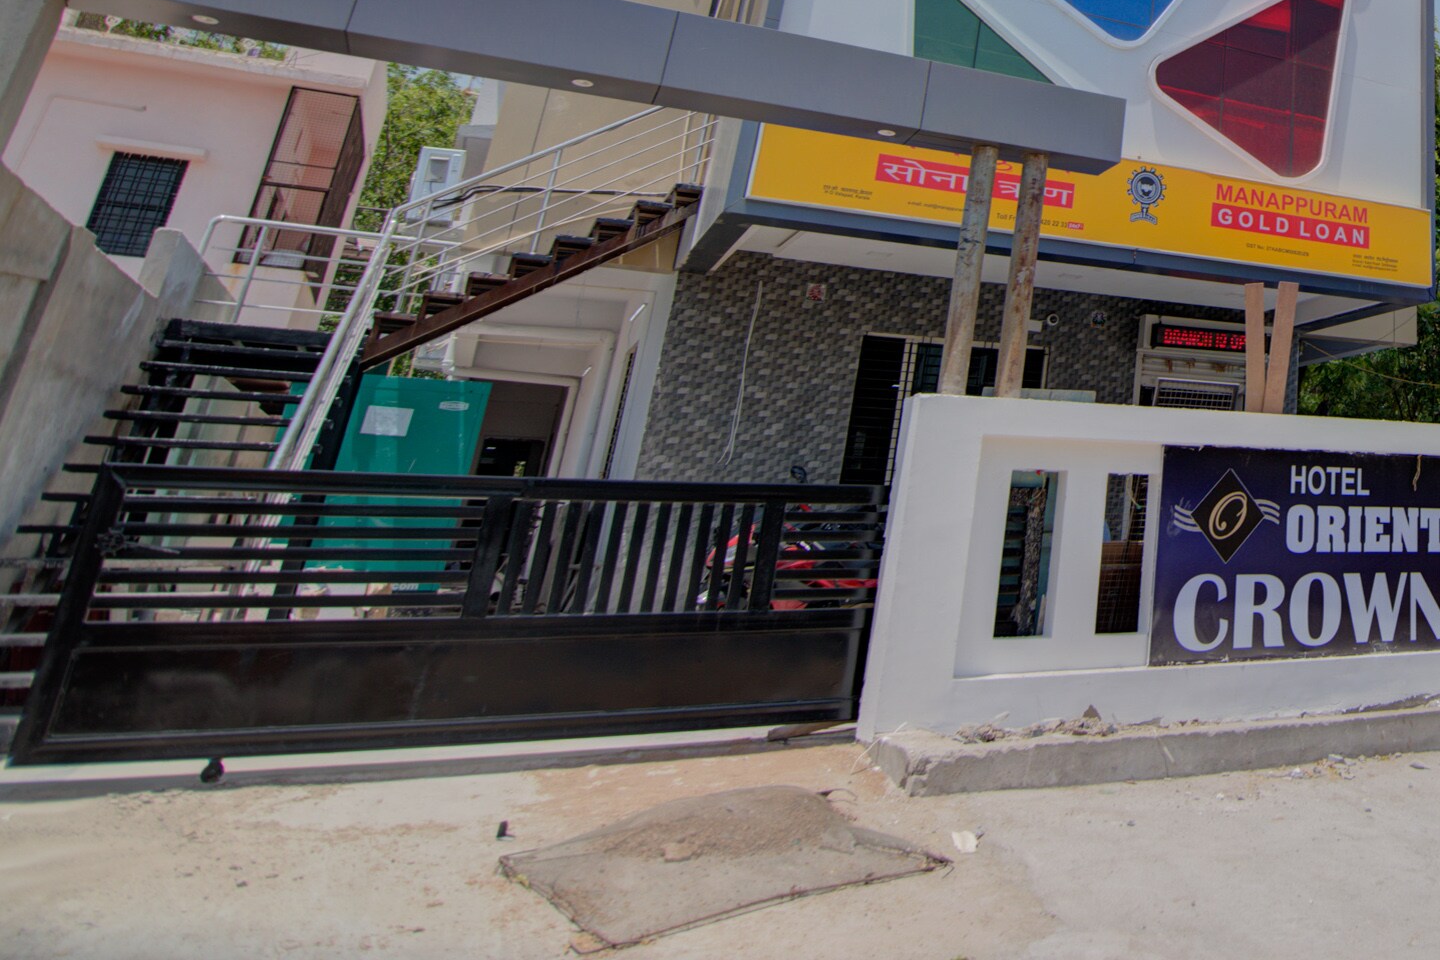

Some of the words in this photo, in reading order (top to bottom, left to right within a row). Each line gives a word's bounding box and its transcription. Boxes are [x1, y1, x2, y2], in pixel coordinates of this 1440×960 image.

[1215, 183, 1368, 224] MANAPPURAM
[1217, 208, 1289, 234] GOLD
[1299, 219, 1366, 246] LOAN
[1290, 465, 1370, 496] HOTEL
